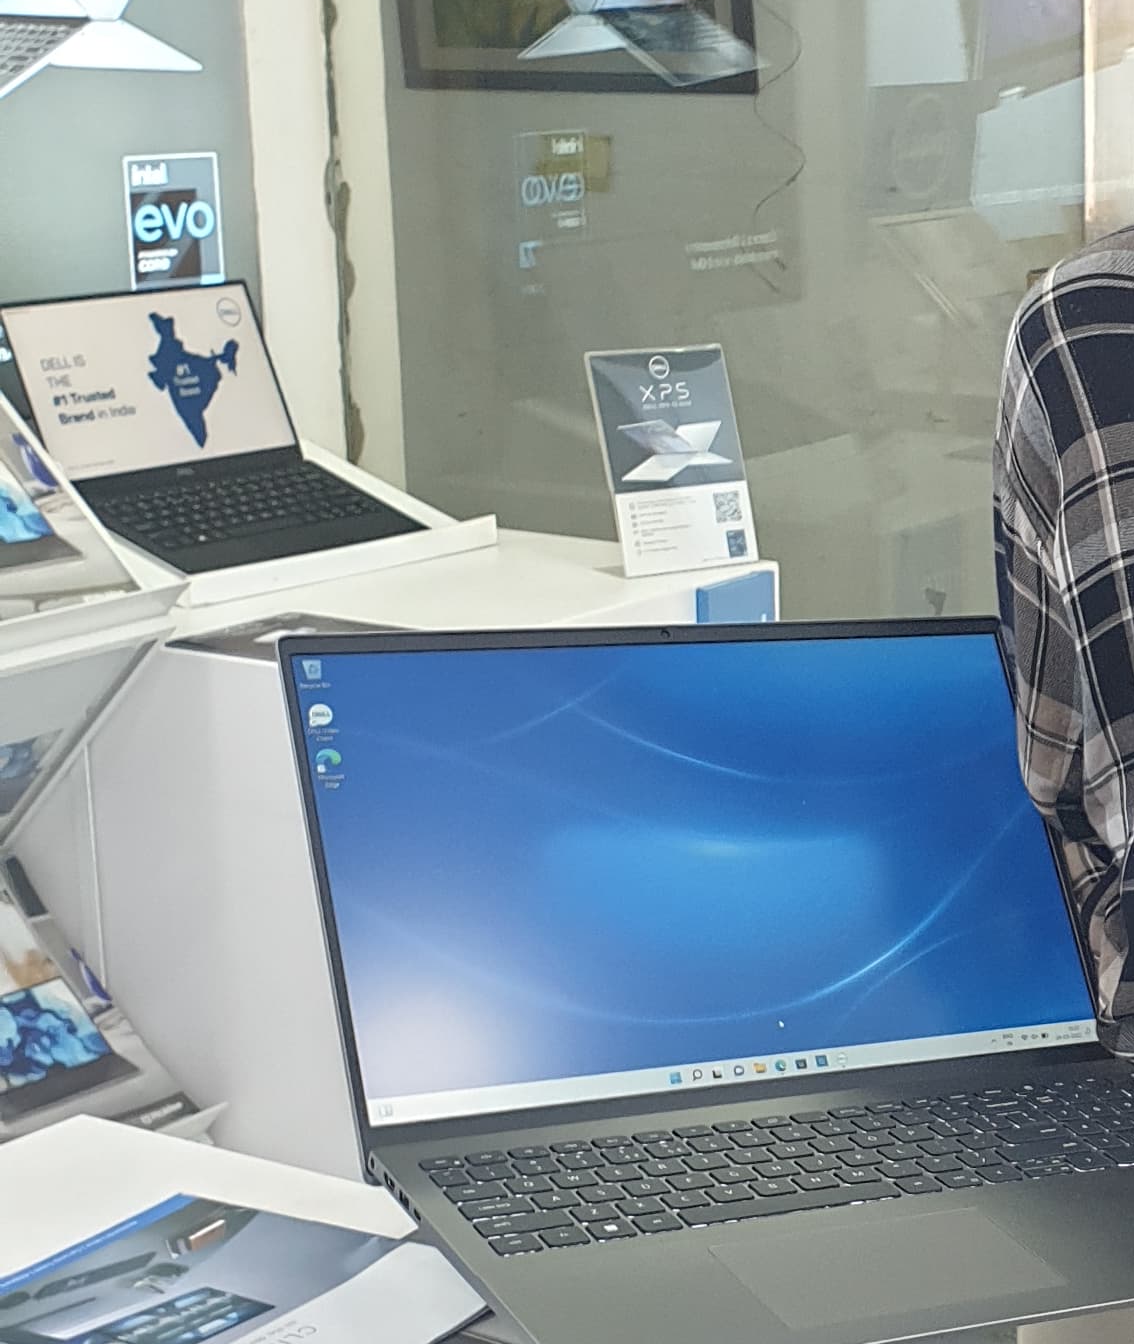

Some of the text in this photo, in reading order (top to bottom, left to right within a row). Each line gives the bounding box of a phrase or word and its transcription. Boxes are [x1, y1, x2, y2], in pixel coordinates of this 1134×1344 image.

[134, 200, 216, 244] evo
[69, 386, 117, 406] Trusted
[639, 381, 690, 404] XPS
[58, 408, 96, 426] Brand
